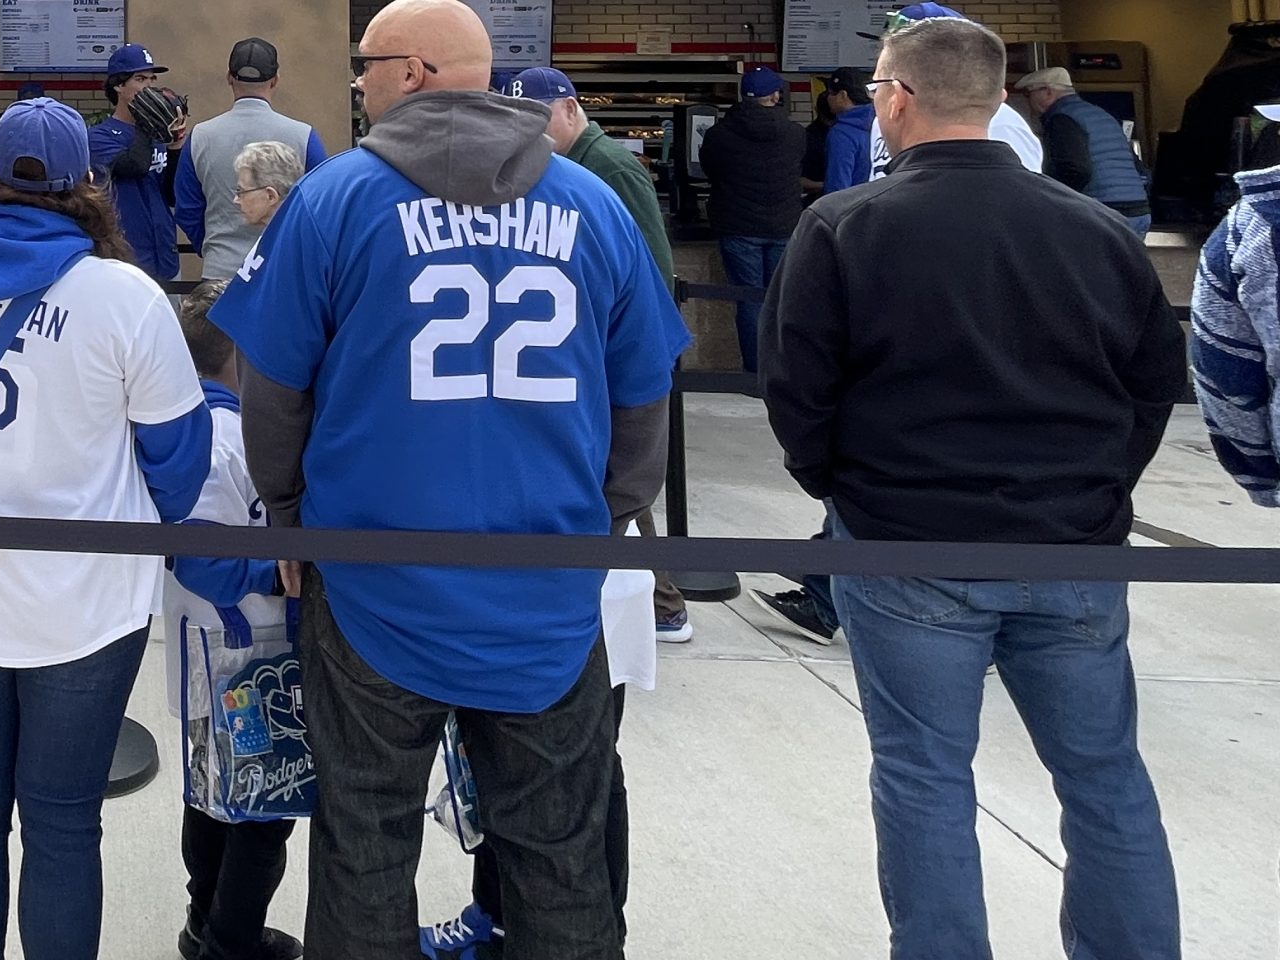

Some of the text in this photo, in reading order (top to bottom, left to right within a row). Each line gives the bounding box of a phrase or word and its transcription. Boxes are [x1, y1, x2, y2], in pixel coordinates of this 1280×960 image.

[512, 80, 523, 98] B
[397, 197, 579, 262] KERSHAW
[409, 264, 577, 402] 22
[235, 752, 317, 802] Dodger
